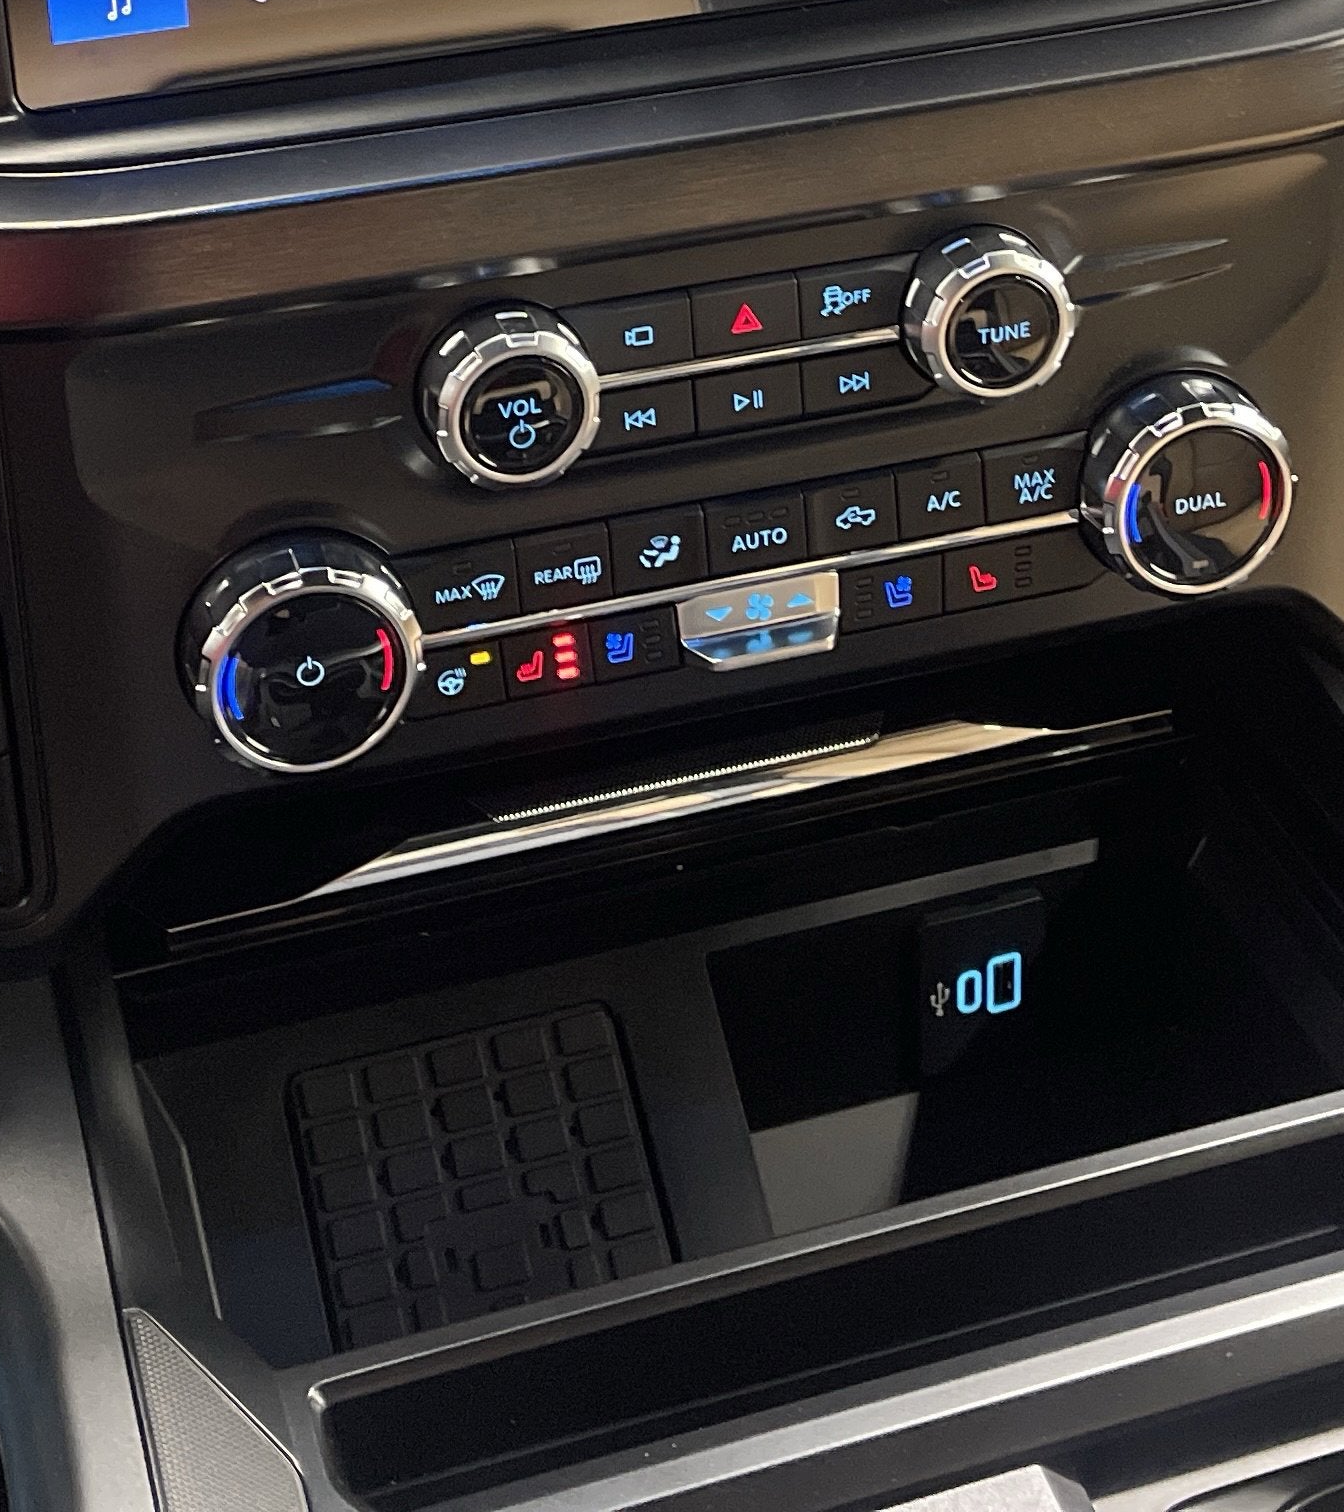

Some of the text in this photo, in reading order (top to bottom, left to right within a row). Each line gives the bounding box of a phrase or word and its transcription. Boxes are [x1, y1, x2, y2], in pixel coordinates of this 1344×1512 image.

[843, 287, 872, 307] OFF
[977, 320, 1032, 345] TUNE
[498, 398, 543, 418] VOL
[1013, 467, 1056, 490] MAX
[926, 489, 962, 513] A/C
[1018, 484, 1054, 505] A/C
[1174, 490, 1227, 516] DUAL
[731, 526, 788, 553] AUTO
[533, 563, 573, 586] REAR
[434, 584, 472, 606] MAX
